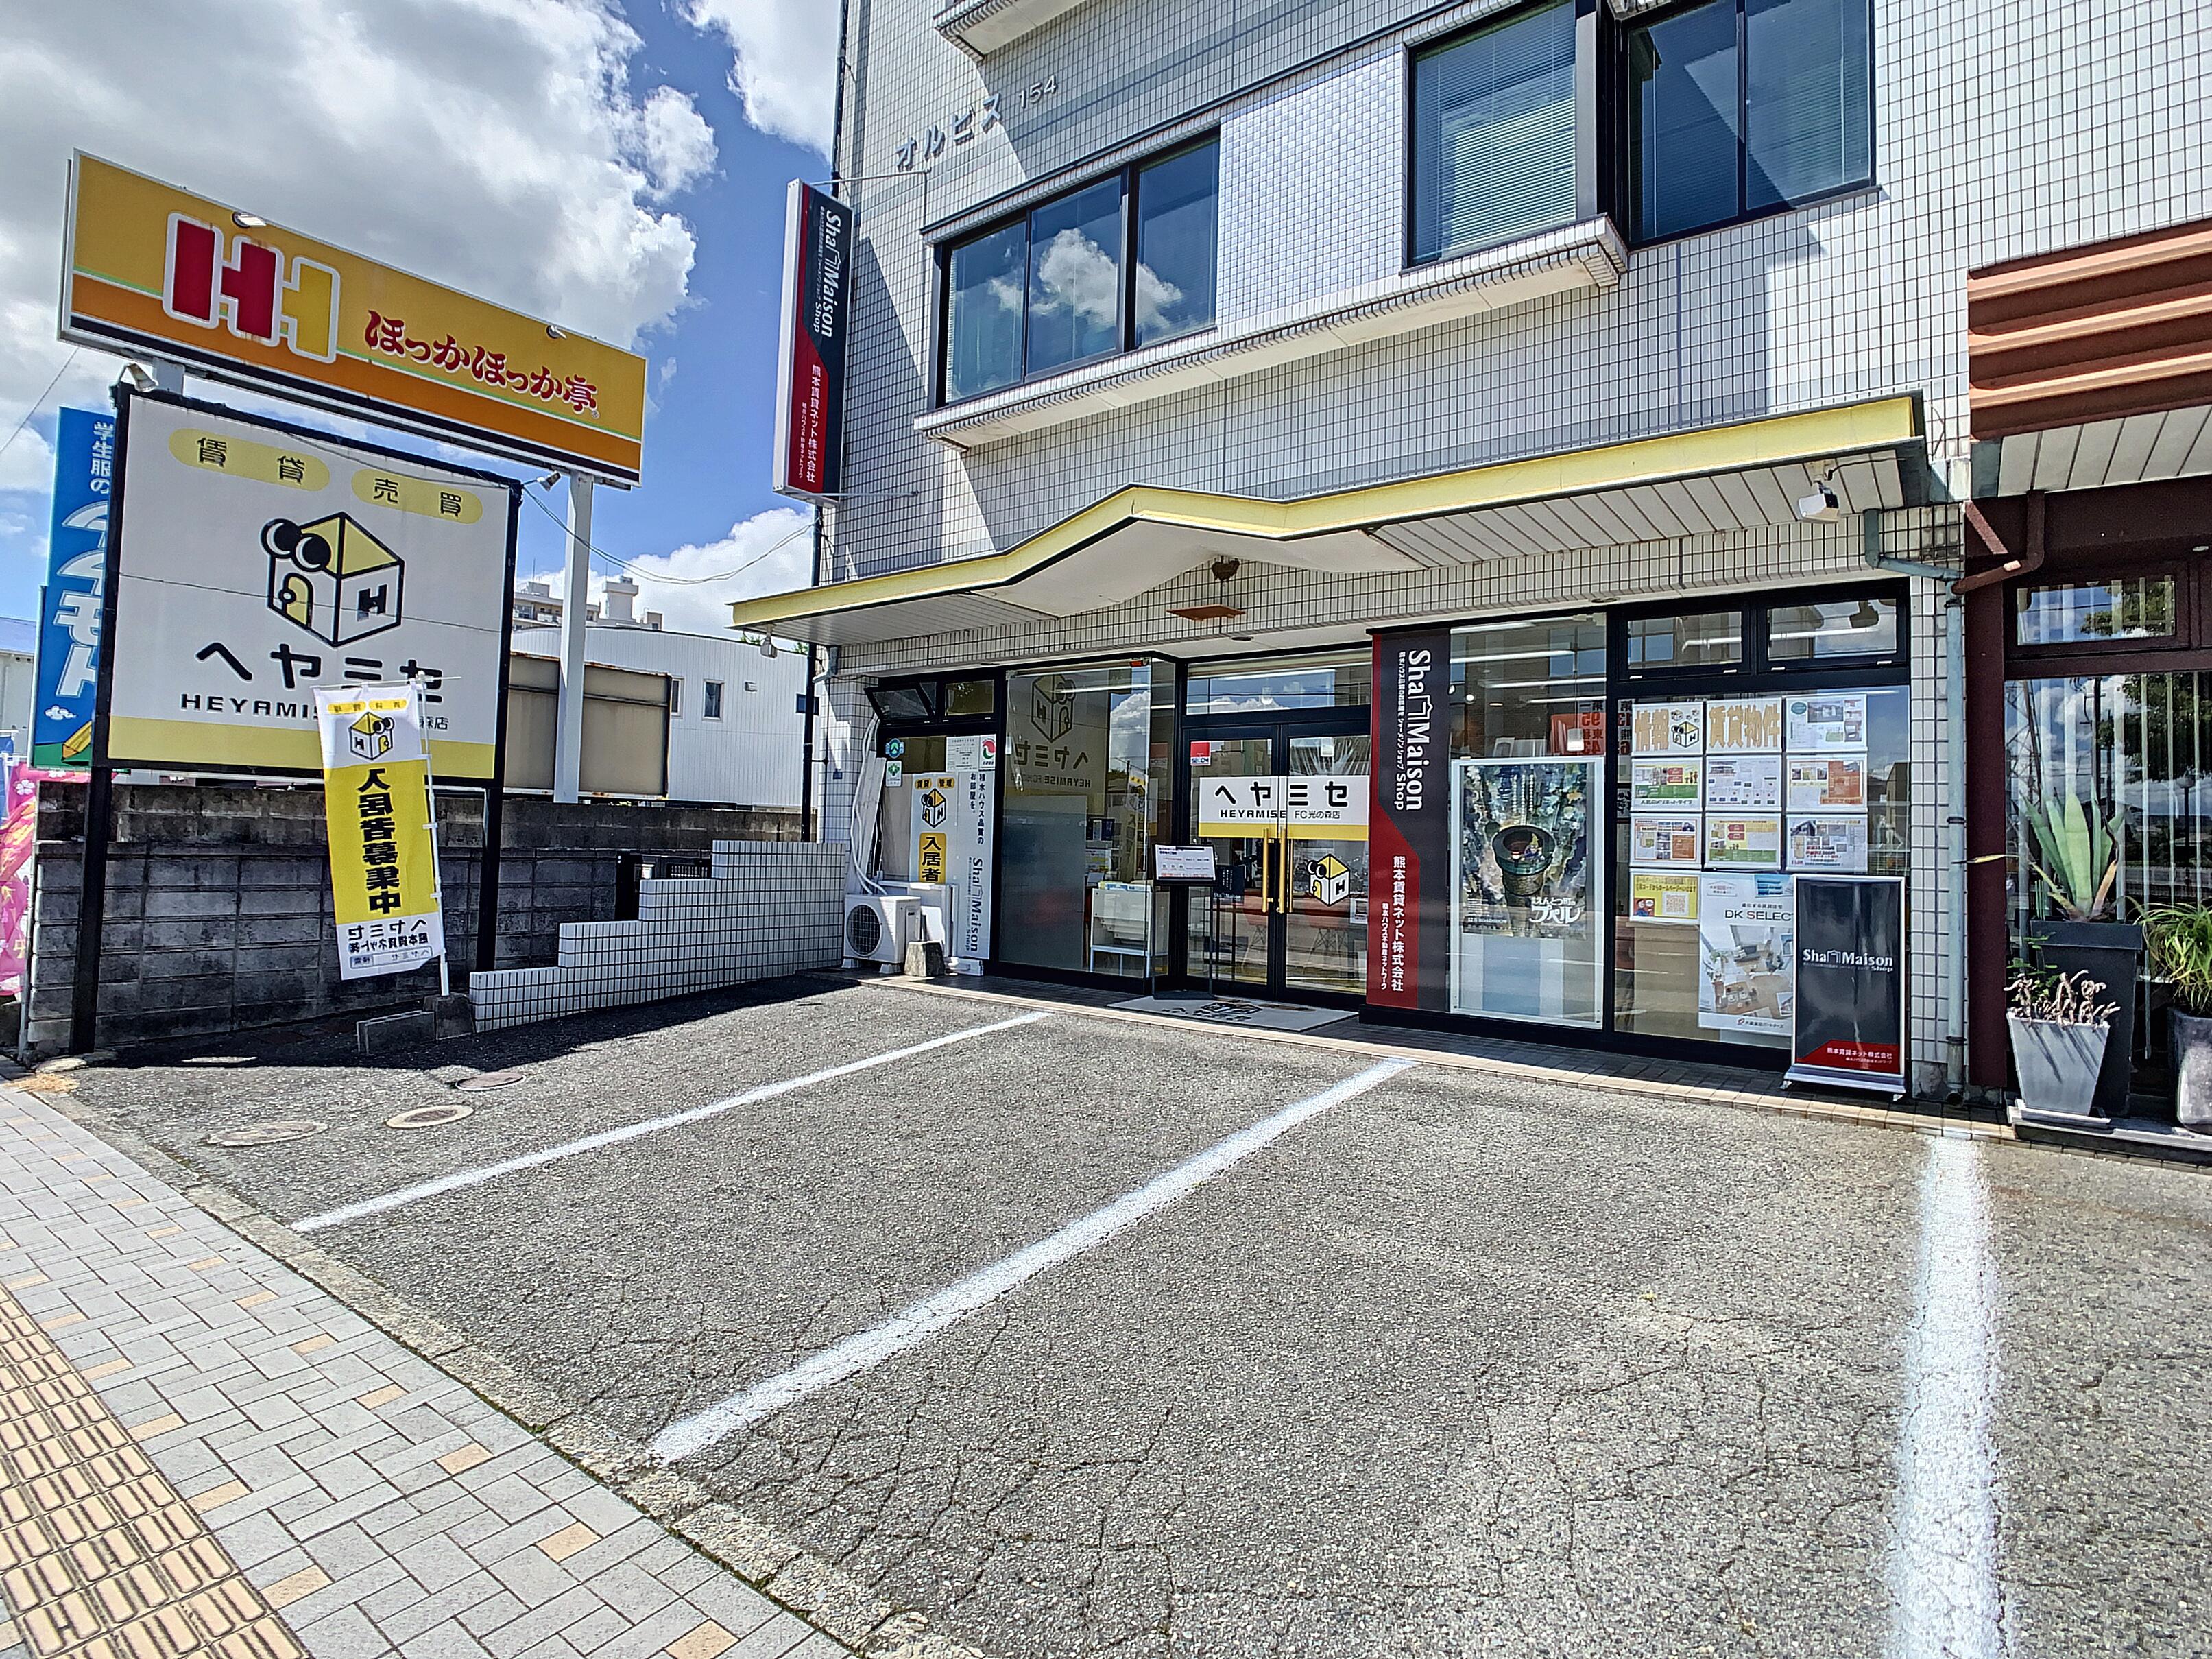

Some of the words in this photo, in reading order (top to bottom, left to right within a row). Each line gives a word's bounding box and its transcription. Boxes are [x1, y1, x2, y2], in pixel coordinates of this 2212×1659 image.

[1019, 74, 1058, 108] 154
[813, 302, 823, 333] Shop
[364, 309, 599, 413] ほっかほっか亭
[196, 437, 306, 484] 賃貸
[373, 477, 462, 517] 売買
[195, 641, 444, 704] ヘヤミセ
[1214, 780, 1348, 807] ヘヤミセ
[1394, 773, 1406, 811] Shop
[1220, 809, 1287, 819] HEYAMISE
[921, 836, 942, 883] 入居者
[1391, 855, 1406, 992] 熊本賃貸ネット株式会社
[1724, 909, 1744, 920] DK
[1747, 911, 1794, 922] SELEC
